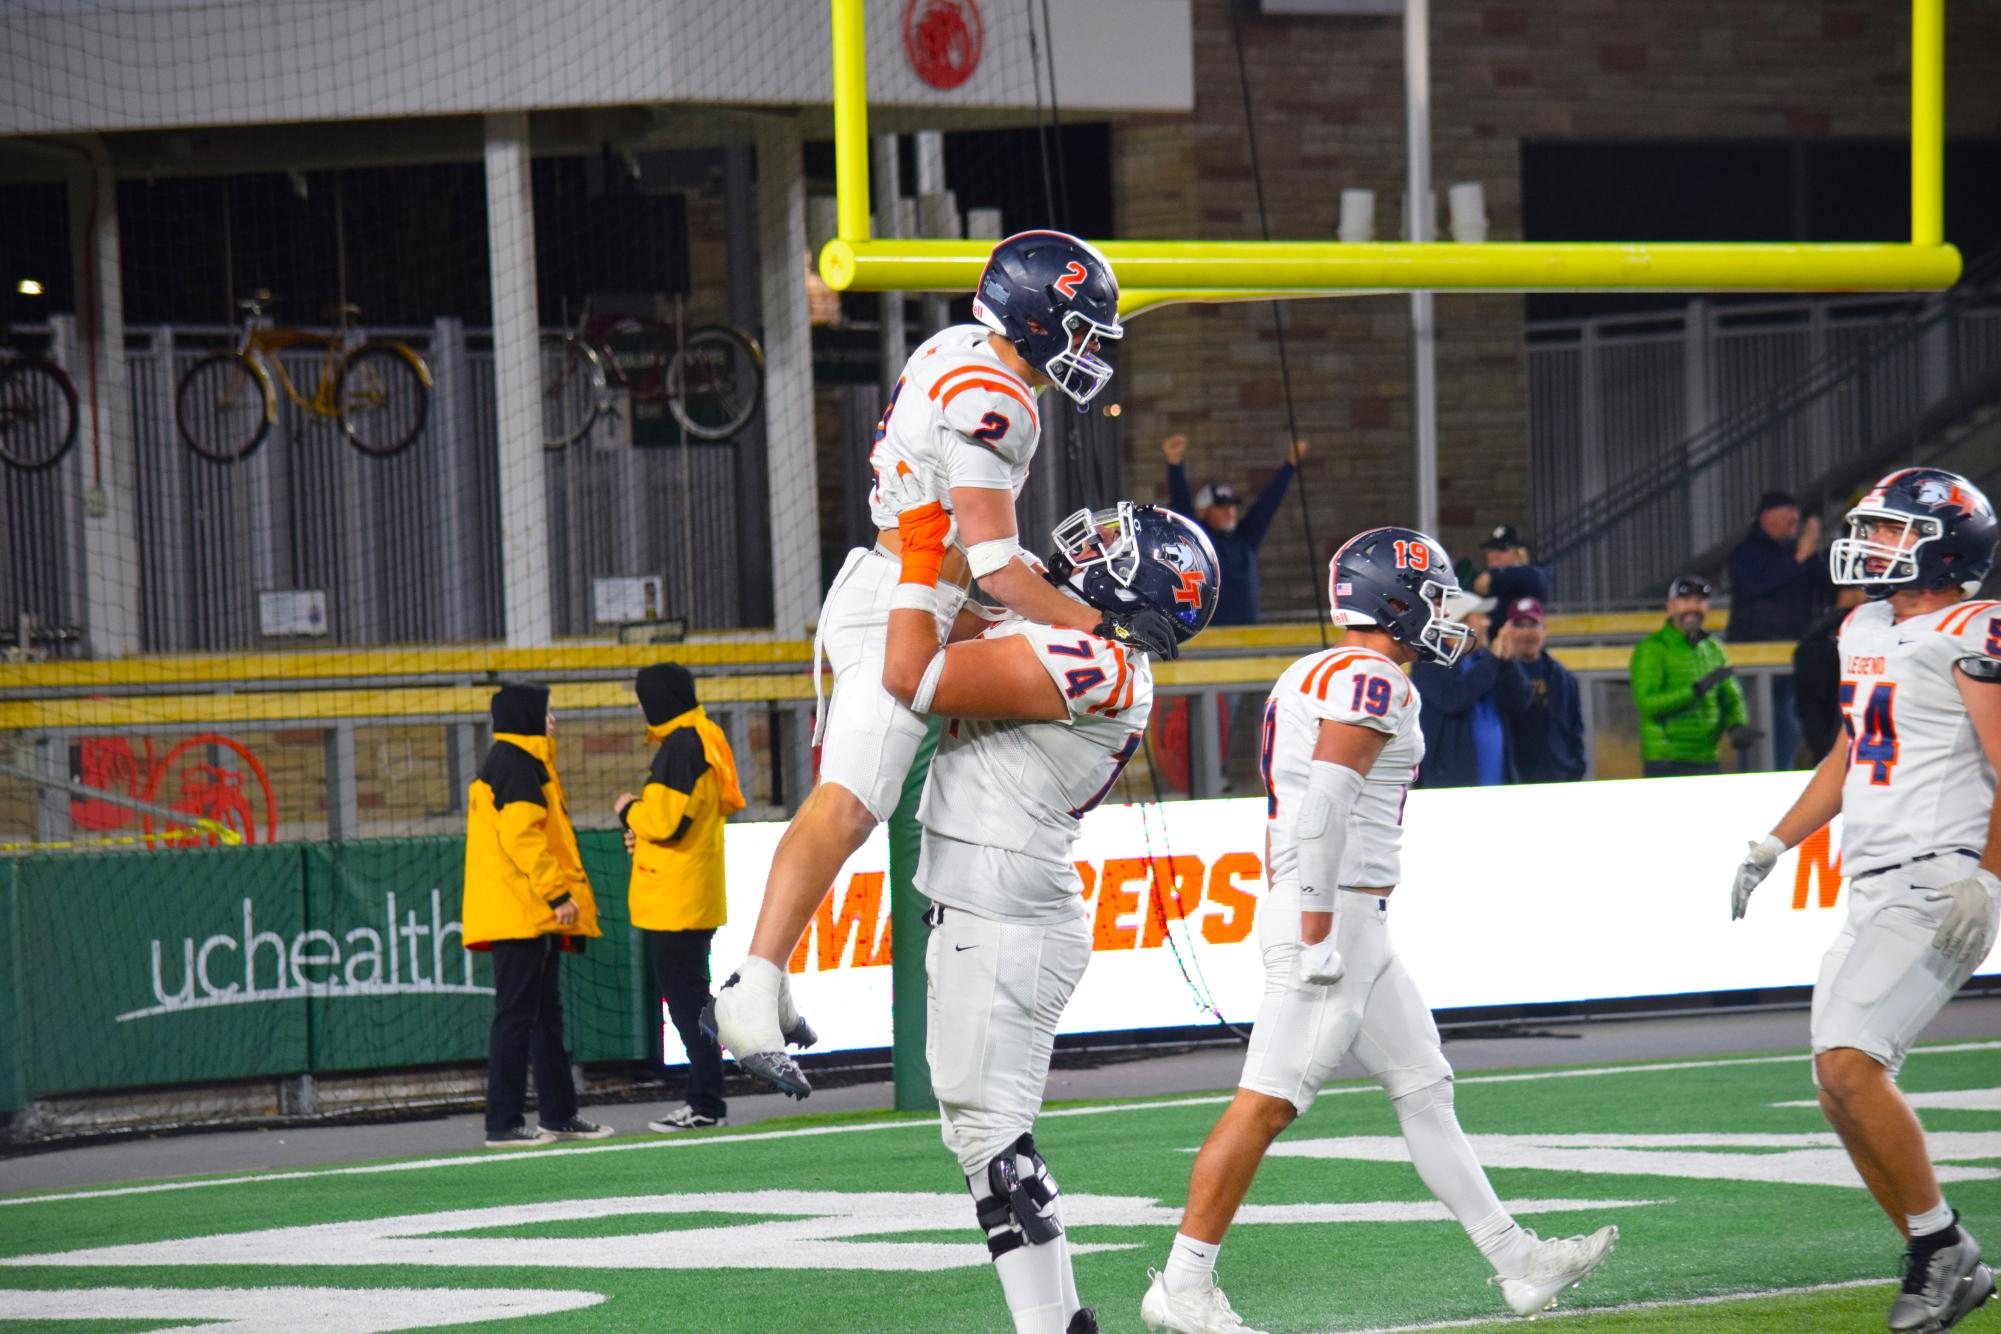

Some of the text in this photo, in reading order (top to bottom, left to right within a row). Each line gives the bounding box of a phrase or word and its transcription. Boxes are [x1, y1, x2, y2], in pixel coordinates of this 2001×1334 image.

[1054, 260, 1088, 300] 2
[972, 410, 1011, 449] 2
[1393, 540, 1429, 571] 19
[1047, 639, 1107, 701] 74
[1847, 655, 1887, 676] LEGEND
[1350, 673, 1392, 717] 19
[151, 888, 473, 1007] uchealth
